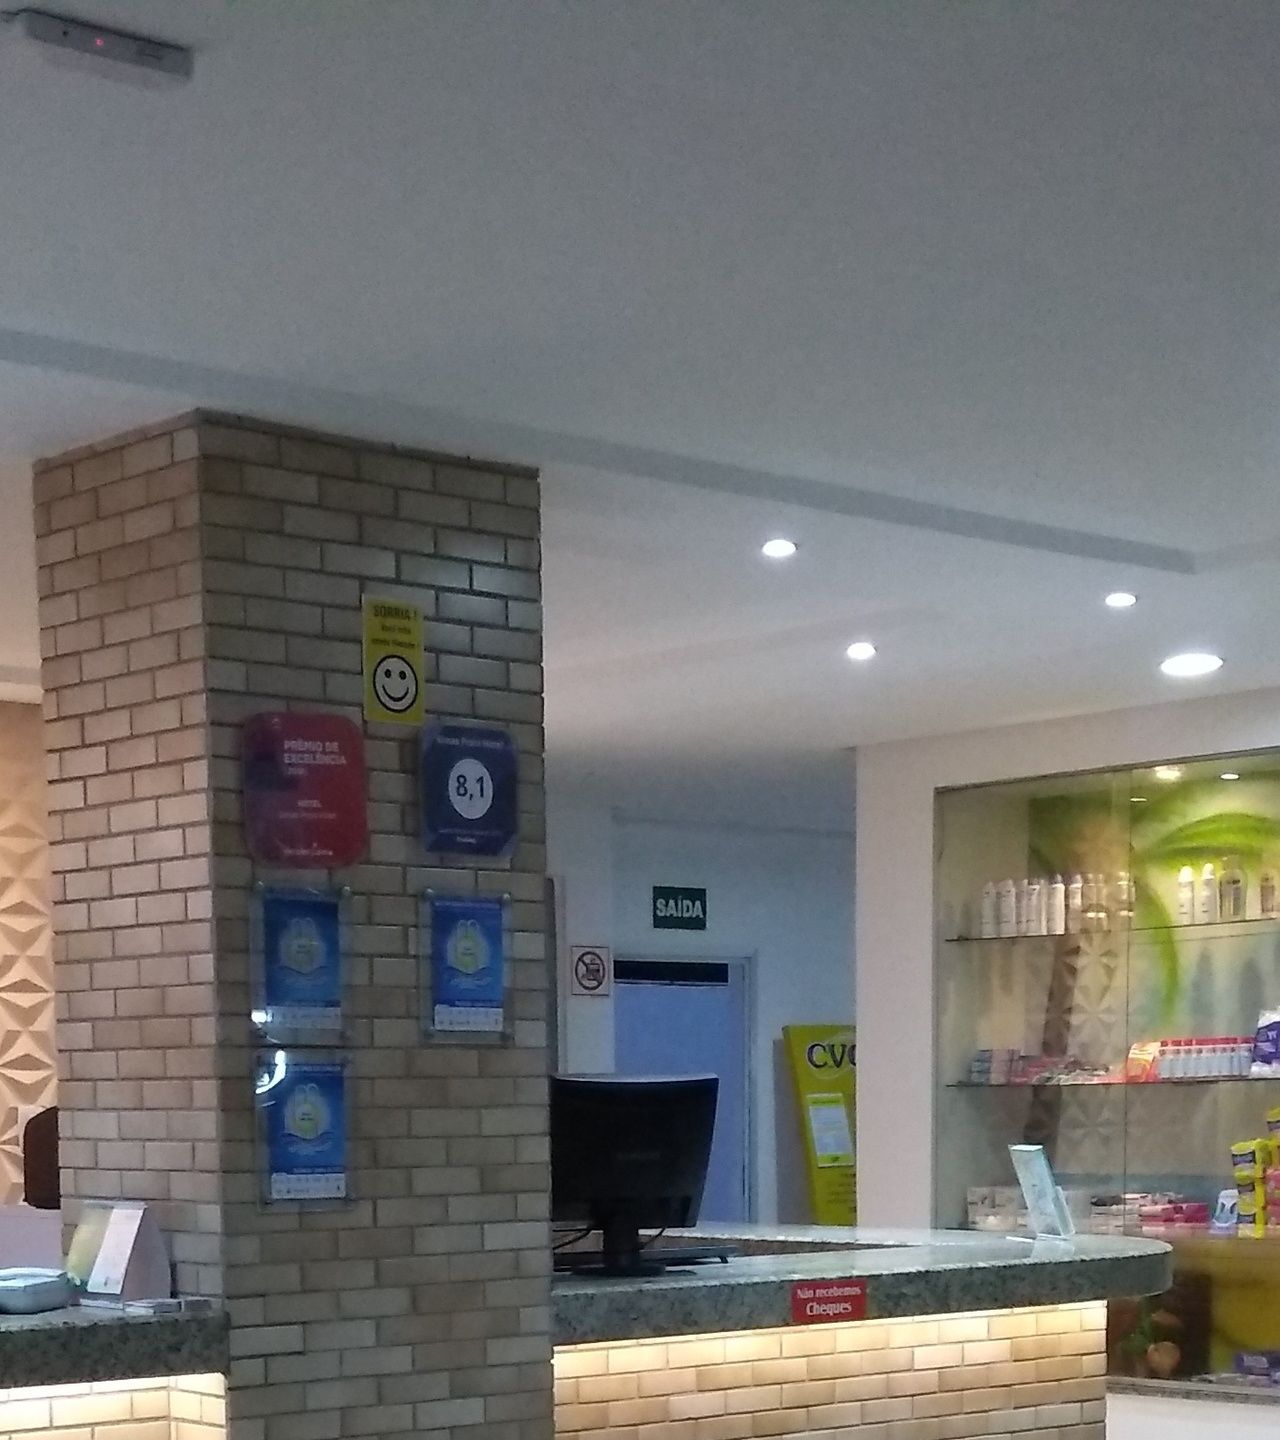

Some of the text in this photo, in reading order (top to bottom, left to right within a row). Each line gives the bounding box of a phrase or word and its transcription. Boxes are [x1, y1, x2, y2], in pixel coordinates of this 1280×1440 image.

[456, 774, 485, 801] 8,1
[655, 895, 704, 919] SAÍDA
[796, 1286, 862, 1299] Não recebemos
[806, 1301, 852, 1316] Cheques
